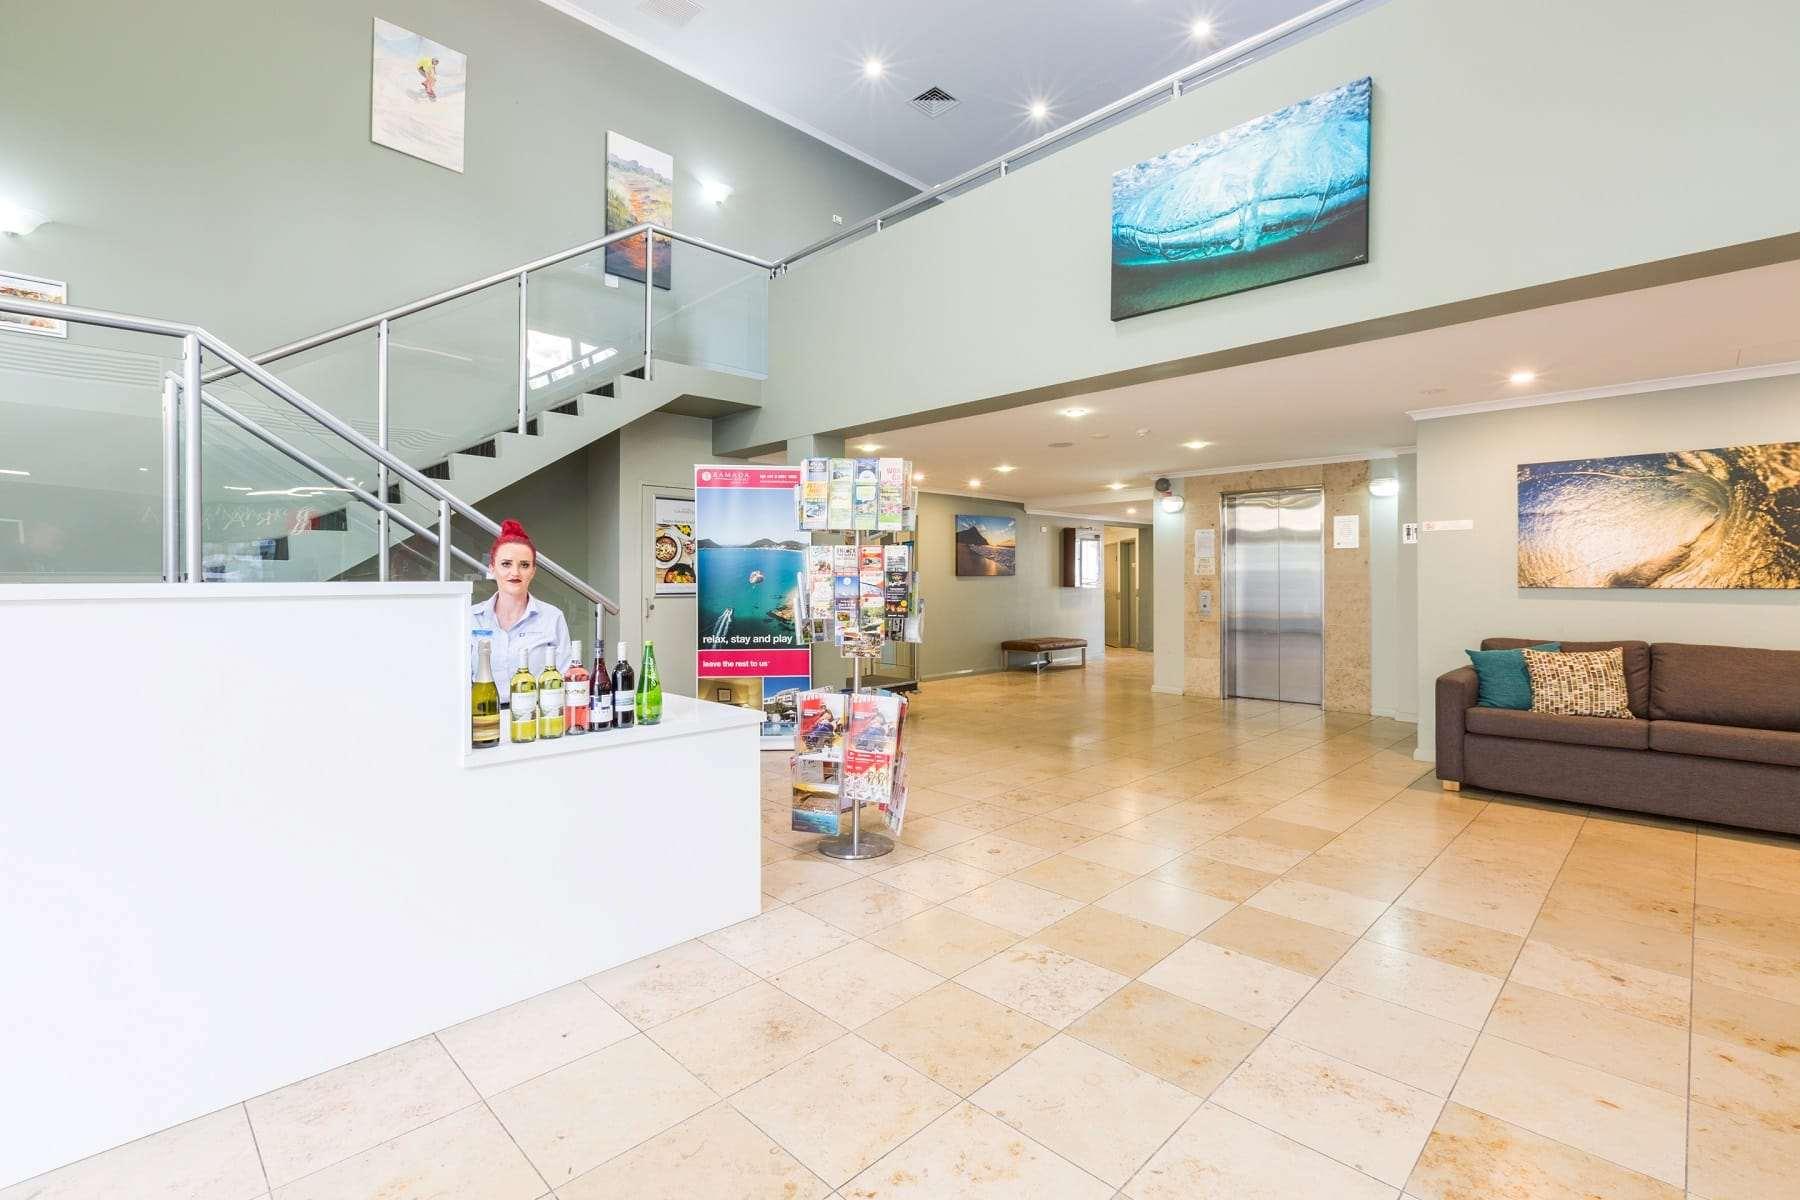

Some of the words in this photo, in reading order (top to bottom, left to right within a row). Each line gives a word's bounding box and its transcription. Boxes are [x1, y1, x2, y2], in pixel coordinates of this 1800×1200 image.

[703, 635, 728, 645] relax,
[731, 635, 751, 645] stay
[753, 635, 771, 643] and
[773, 634, 792, 645] play
